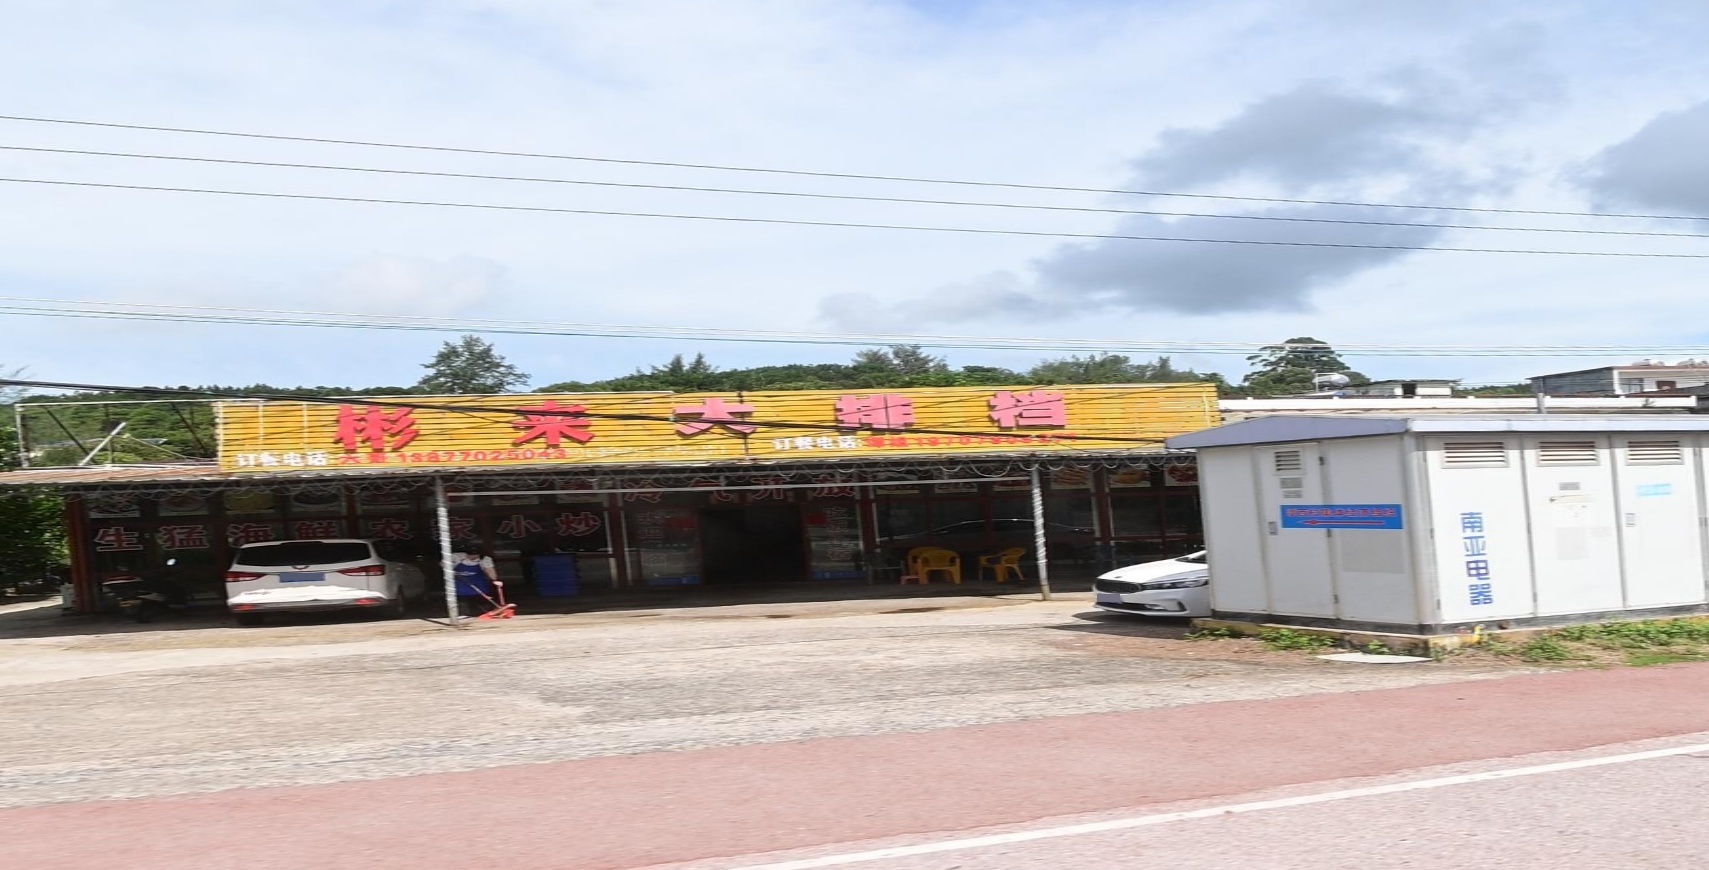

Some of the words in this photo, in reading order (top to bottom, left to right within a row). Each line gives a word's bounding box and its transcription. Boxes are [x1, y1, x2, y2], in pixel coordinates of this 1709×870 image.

[333, 389, 1066, 453] 彬来大排档
[1460, 511, 1494, 606] 南亚电器
